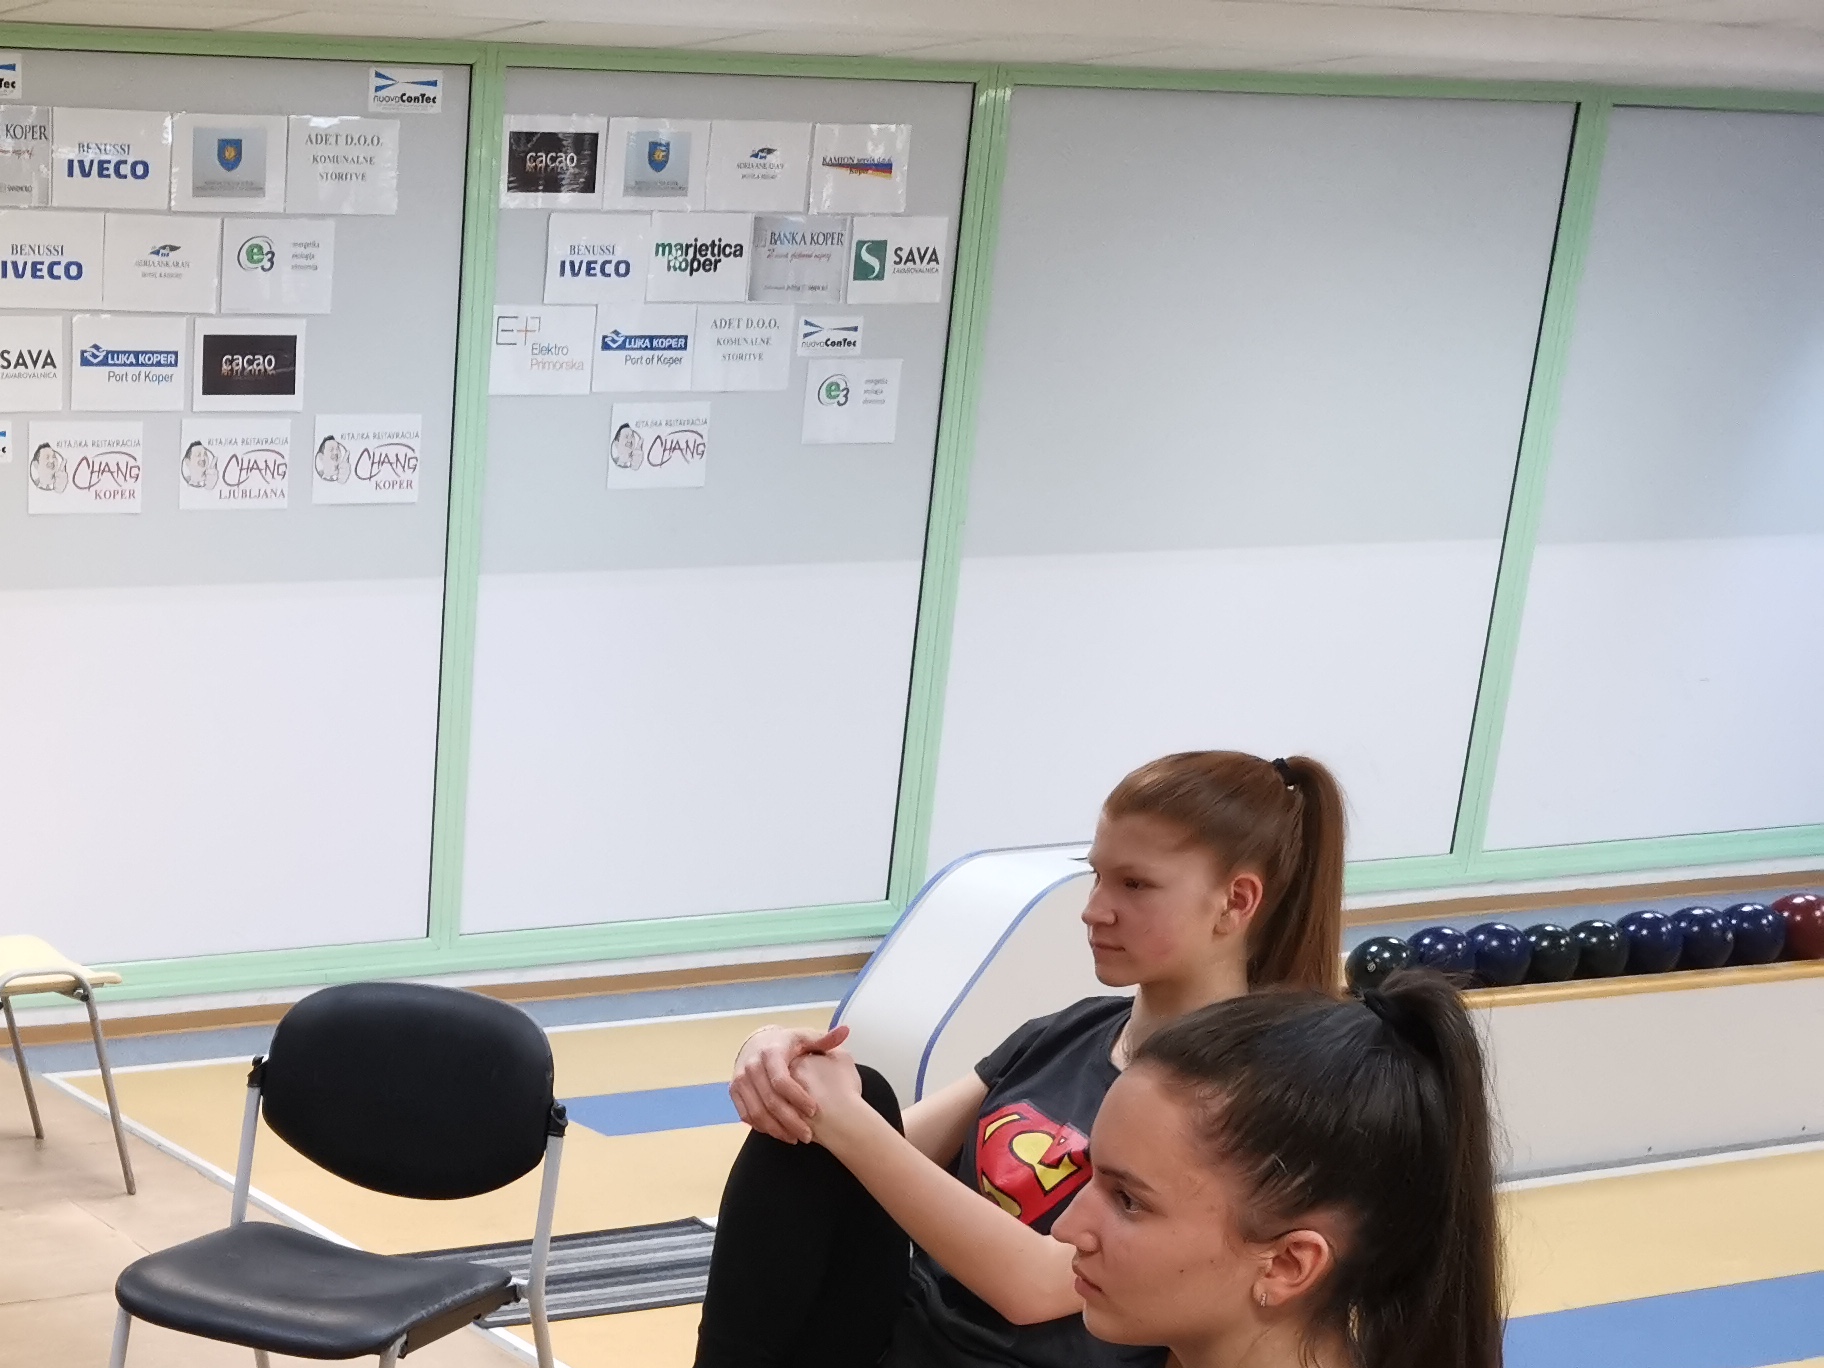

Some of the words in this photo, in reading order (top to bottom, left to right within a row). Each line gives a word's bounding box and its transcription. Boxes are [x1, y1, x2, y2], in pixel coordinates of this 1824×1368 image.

[373, 92, 437, 104] nuovaConTec
[5, 123, 49, 141] KOPER
[305, 133, 340, 147] ADET
[78, 142, 131, 155] BENUSSI
[312, 154, 375, 166] KOMUNALNE
[526, 152, 577, 168] cacao
[822, 156, 855, 164] KAMION
[67, 159, 150, 180] IVECO
[319, 171, 367, 182] STORITVE
[769, 231, 807, 246] BANKA
[809, 231, 844, 247] KOPER
[10, 243, 64, 256] BENUSSI
[569, 244, 617, 256] BENUSSI
[654, 237, 744, 260] marjetica
[893, 246, 940, 265] SAVA
[1, 260, 83, 281] IVECO
[559, 259, 631, 278] IVECO
[710, 318, 742, 329] ADET
[531, 343, 569, 356] Elektro
[625, 337, 650, 349] LUKA
[652, 338, 686, 349] KOPER
[0, 349, 58, 370] SAVA
[107, 353, 136, 365] LUKA
[138, 353, 175, 365] KOPER
[222, 354, 276, 371] cacao
[530, 358, 584, 371] Primorska
[624, 354, 644, 365] Port
[645, 354, 655, 365] of
[107, 370, 128, 382] Port
[130, 370, 142, 382] of
[144, 371, 174, 385] Koper
[647, 429, 706, 468] CHANG
[355, 443, 418, 481] CHANG
[72, 451, 140, 491] CHANG
[222, 449, 287, 489] CHANG
[375, 479, 414, 490] KOPER
[94, 489, 136, 500] KOPER
[219, 488, 286, 500] LJUBLJANA
